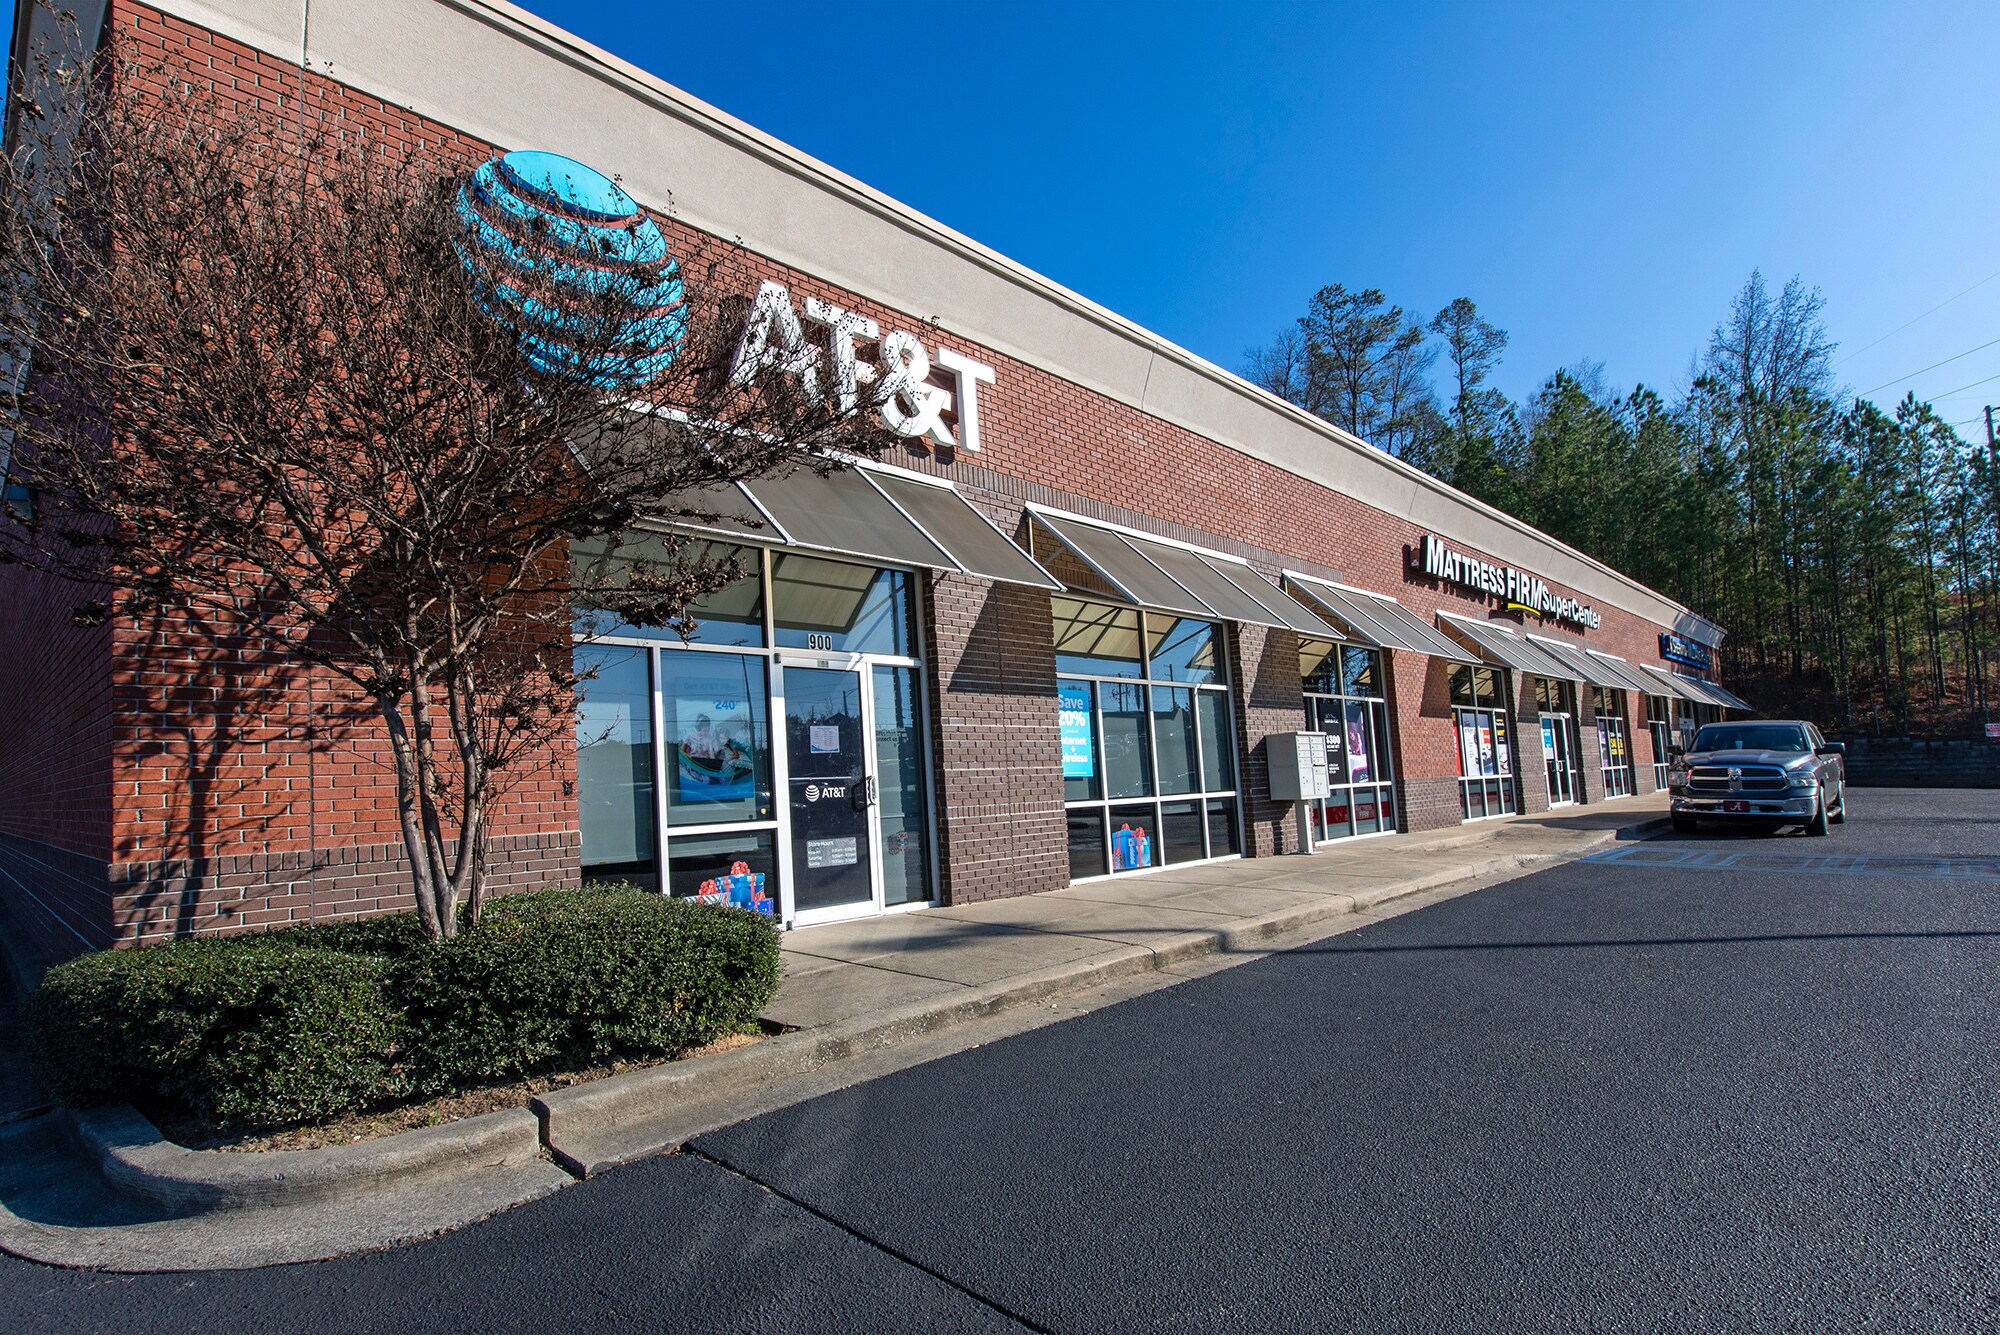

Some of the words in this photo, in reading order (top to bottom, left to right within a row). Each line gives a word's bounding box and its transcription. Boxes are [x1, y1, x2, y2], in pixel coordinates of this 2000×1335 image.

[728, 279, 996, 453] AT&T
[1506, 567, 1544, 611] FIRM
[1541, 586, 1601, 630] SuperCenter
[809, 634, 832, 650] 900
[1058, 694, 1084, 709] Save
[1059, 710, 1086, 727] 20%
[1061, 736, 1087, 745] nternet
[822, 787, 846, 799] AT&T
